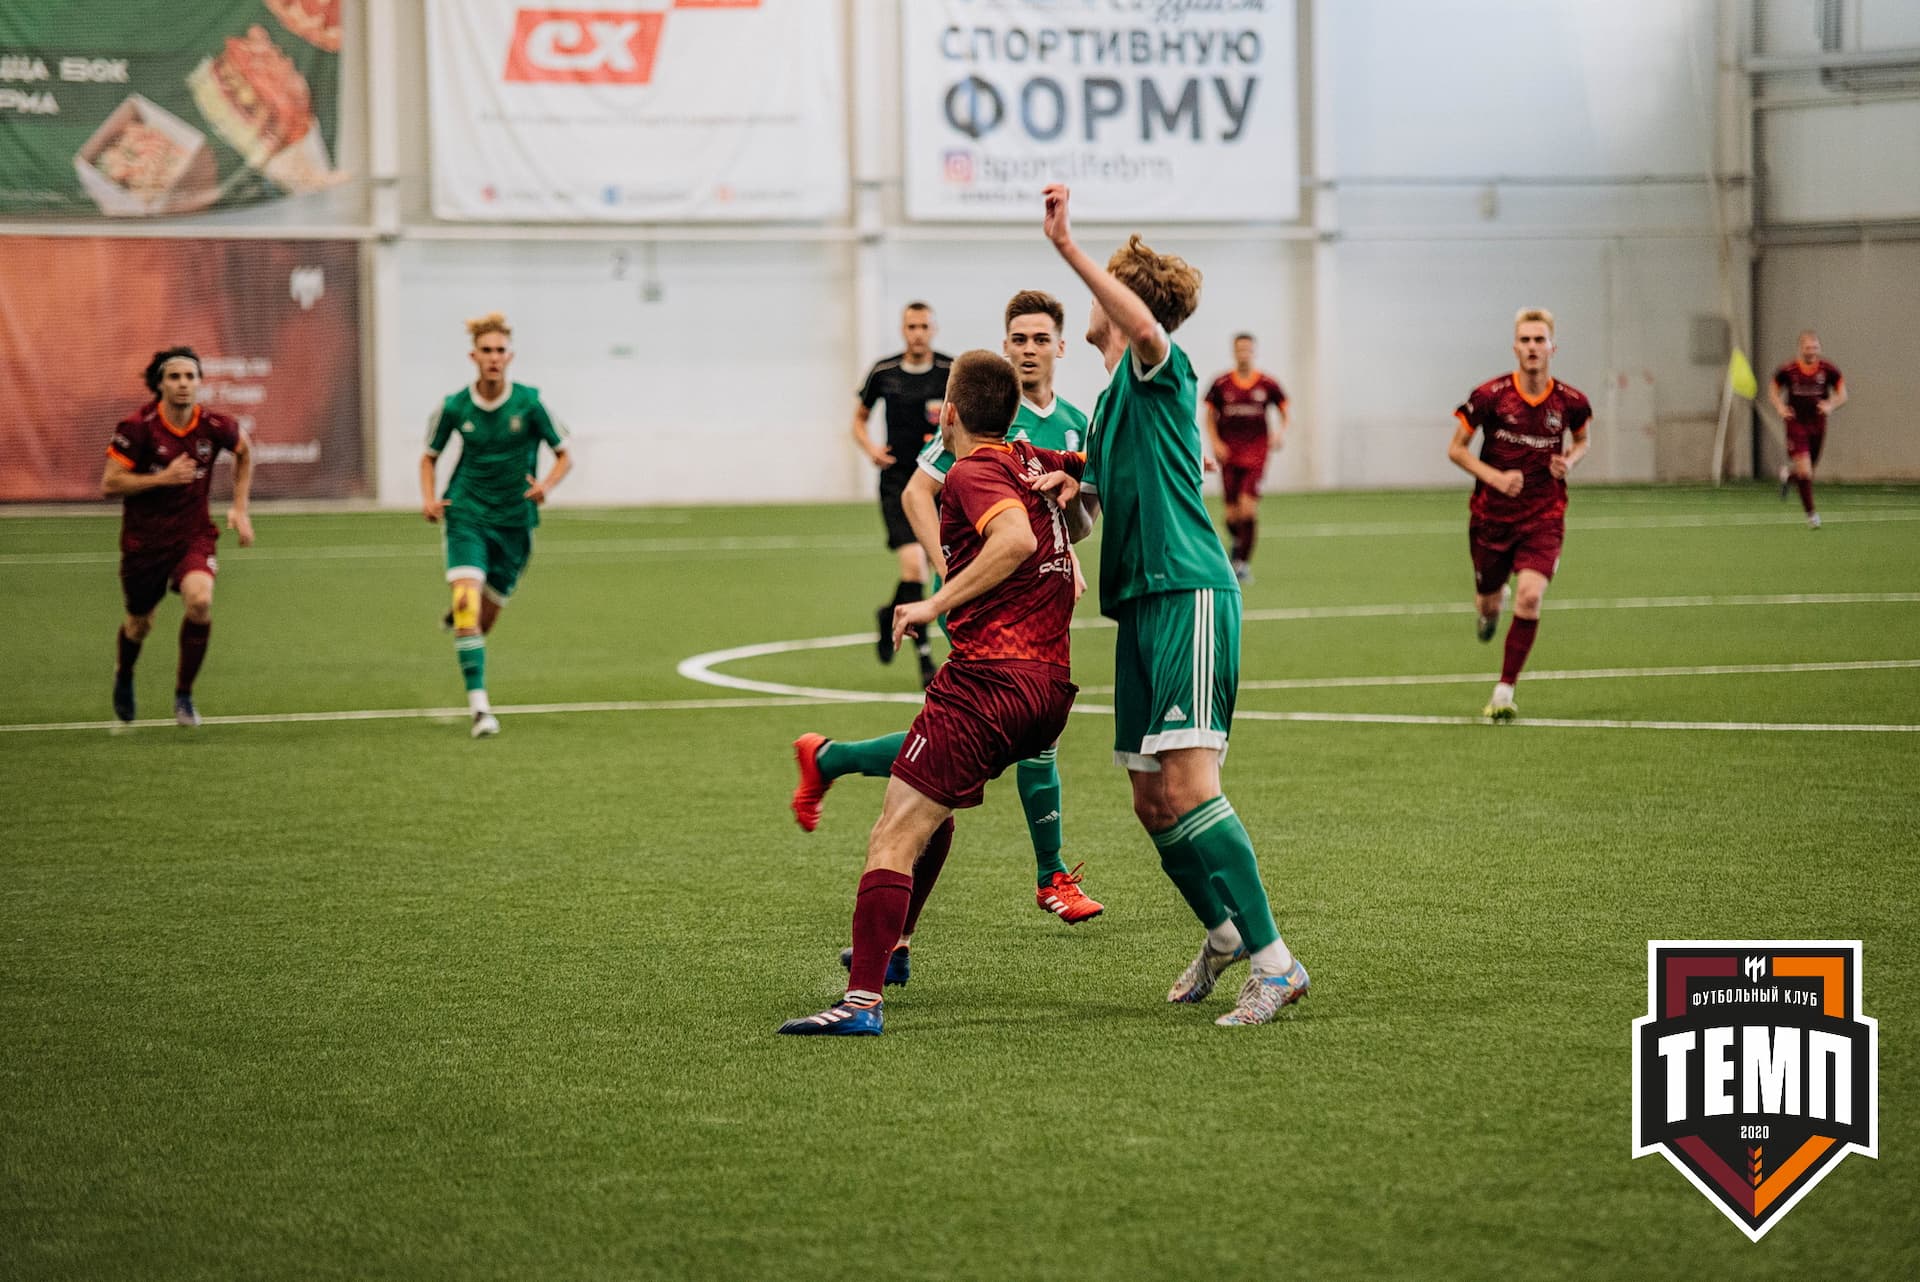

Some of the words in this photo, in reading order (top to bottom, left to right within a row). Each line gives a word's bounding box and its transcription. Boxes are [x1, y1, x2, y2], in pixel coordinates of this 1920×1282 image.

[941, 26, 1264, 65] СПОРТИВНУЮ
[943, 75, 1258, 142] ФОРМУ
[905, 734, 928, 764] 11
